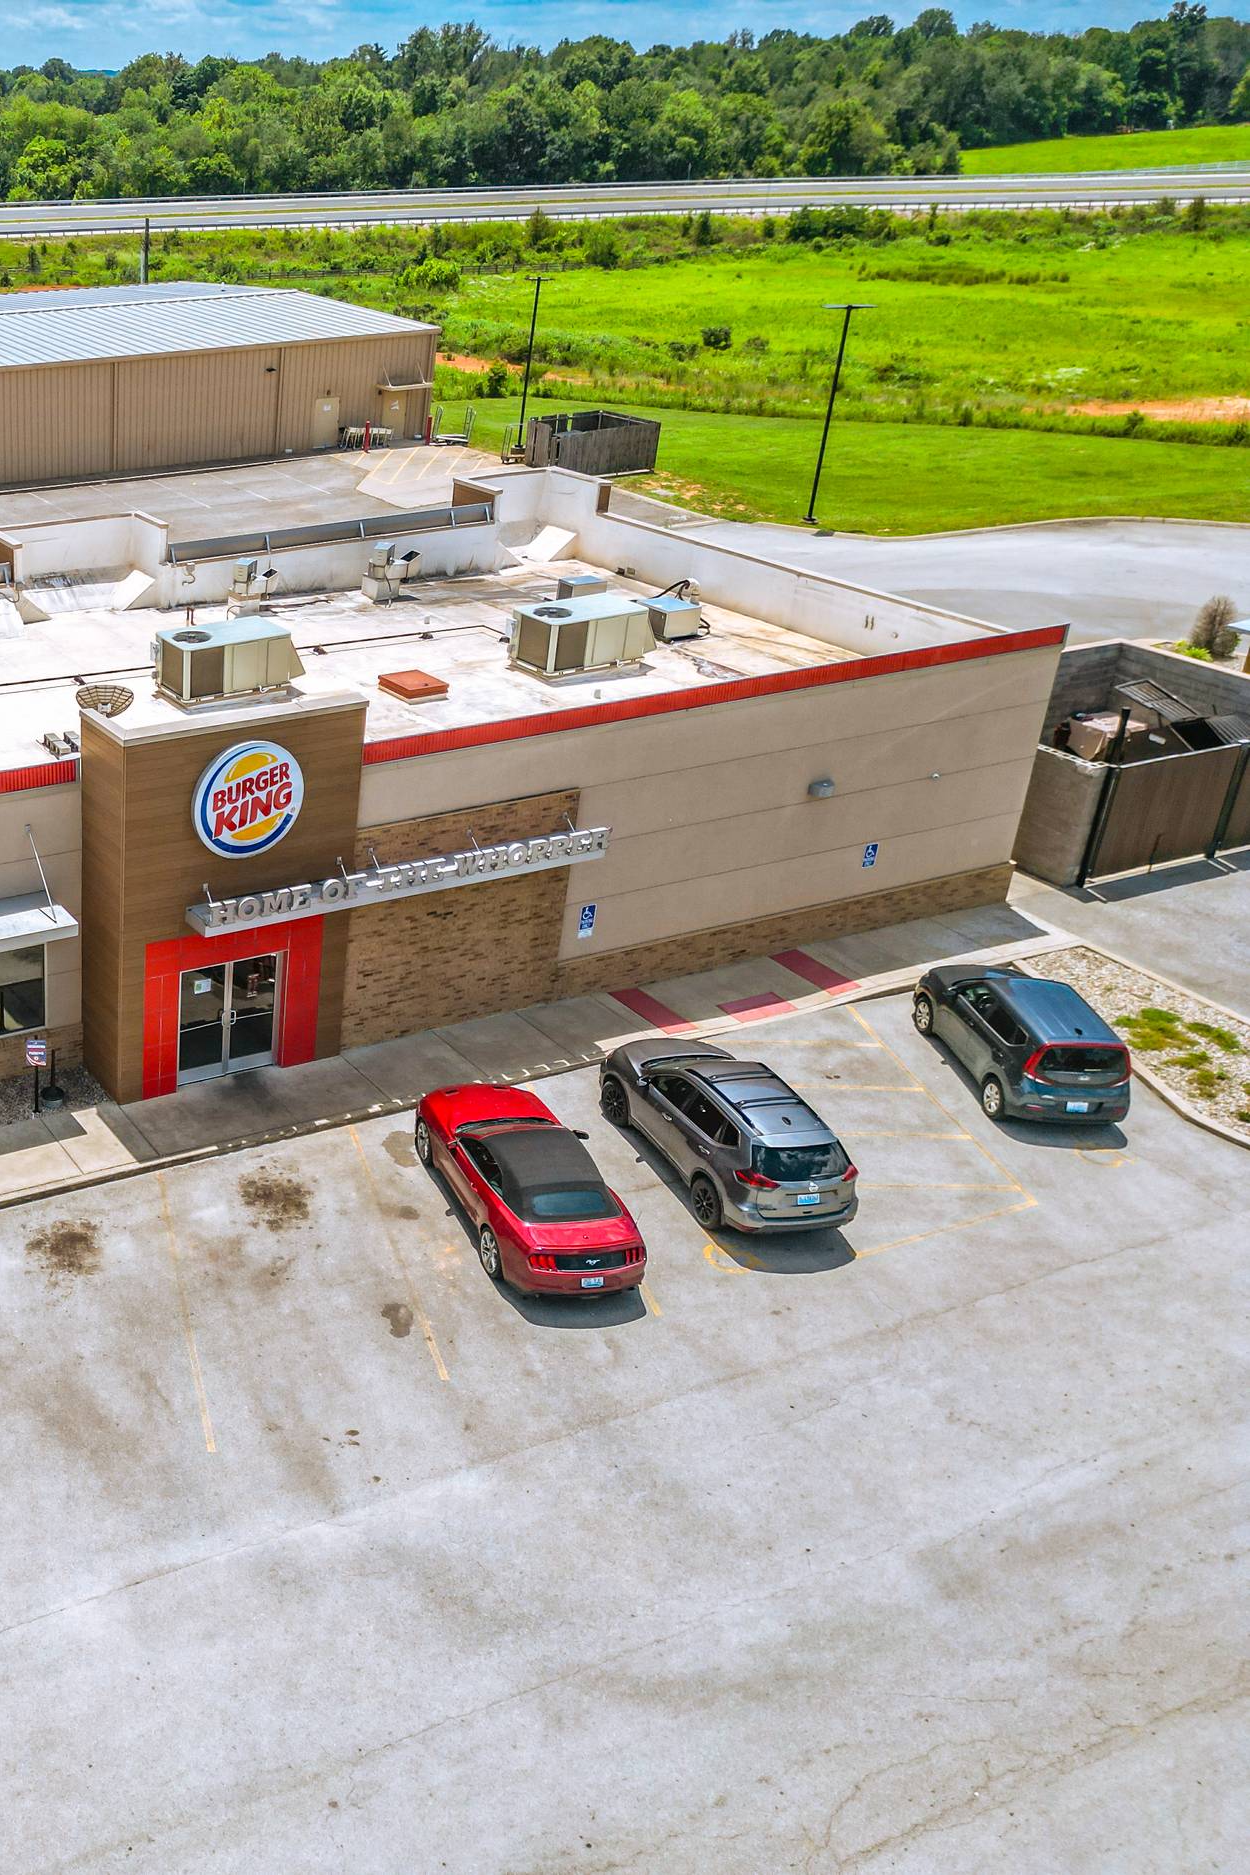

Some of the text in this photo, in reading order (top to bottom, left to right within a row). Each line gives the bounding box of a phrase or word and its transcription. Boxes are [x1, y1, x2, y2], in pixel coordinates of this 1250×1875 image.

[213, 762, 290, 812] BURGER
[214, 782, 292, 838] KING
[209, 827, 610, 928] HOME OF THE WHOPPER
